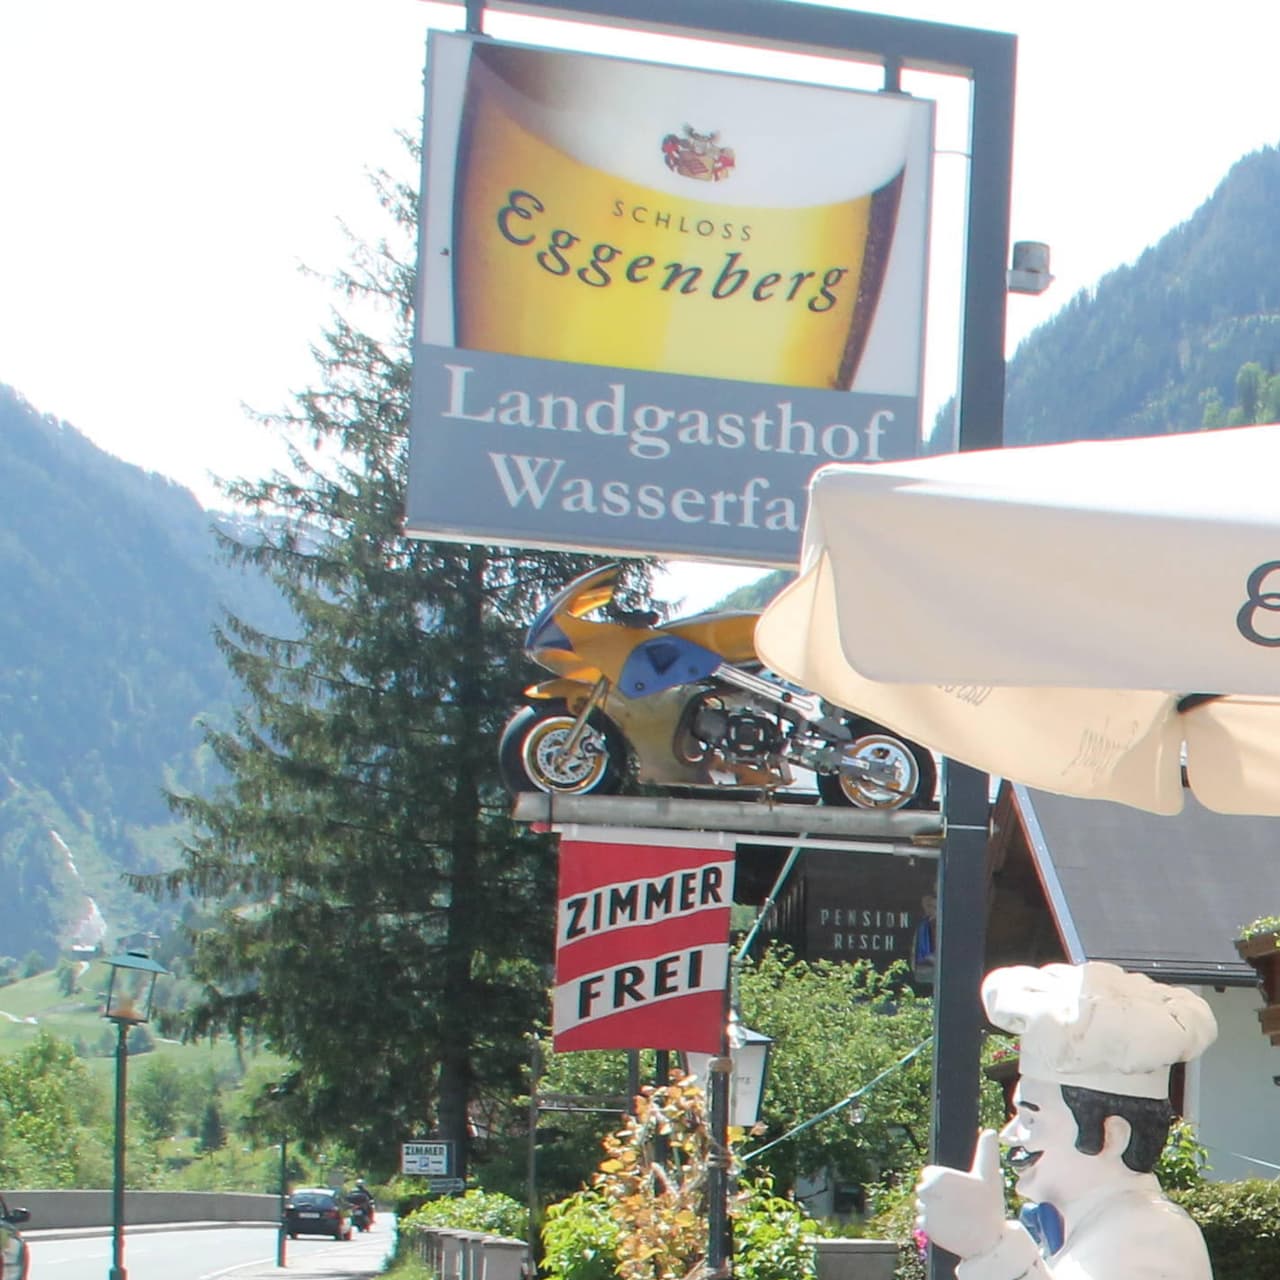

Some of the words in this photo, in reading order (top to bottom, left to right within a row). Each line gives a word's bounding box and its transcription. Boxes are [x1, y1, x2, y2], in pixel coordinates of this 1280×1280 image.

[496, 189, 850, 313] Eggenberg
[612, 199, 753, 242] SCHLOSS
[440, 363, 896, 461] Landgasthof
[488, 451, 801, 532] Wasserfa
[566, 865, 723, 940] ZIMMER
[820, 908, 909, 929] PENSION
[834, 933, 894, 950] RESCH
[578, 950, 703, 1020] FREI
[405, 1146, 445, 1156] ZIMMER
